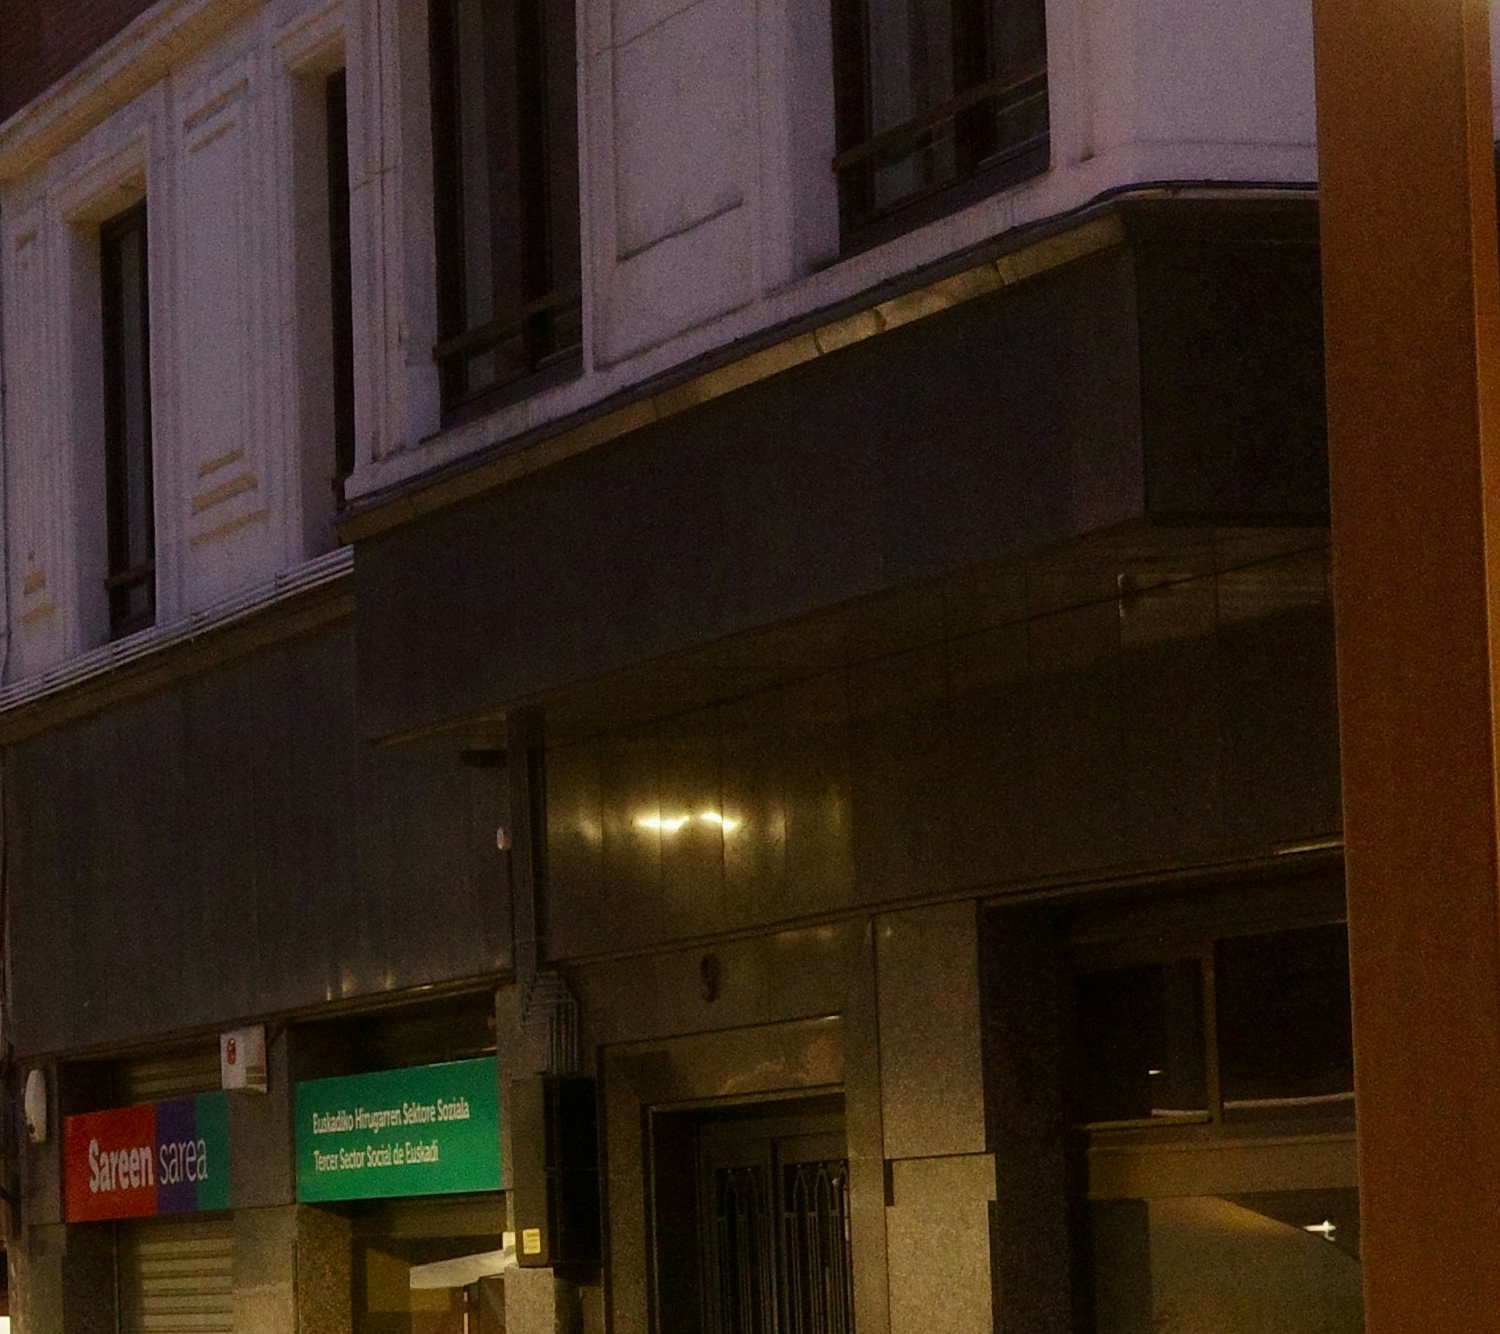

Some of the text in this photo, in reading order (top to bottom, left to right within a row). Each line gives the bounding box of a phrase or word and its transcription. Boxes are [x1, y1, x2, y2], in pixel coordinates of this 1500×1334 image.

[312, 1096, 470, 1135] Euskadiko Hirugarren Sektore Soziala
[88, 1137, 208, 1194] Sareen sarea
[313, 1139, 440, 1172] Tercer Sector Social de Euskadi
